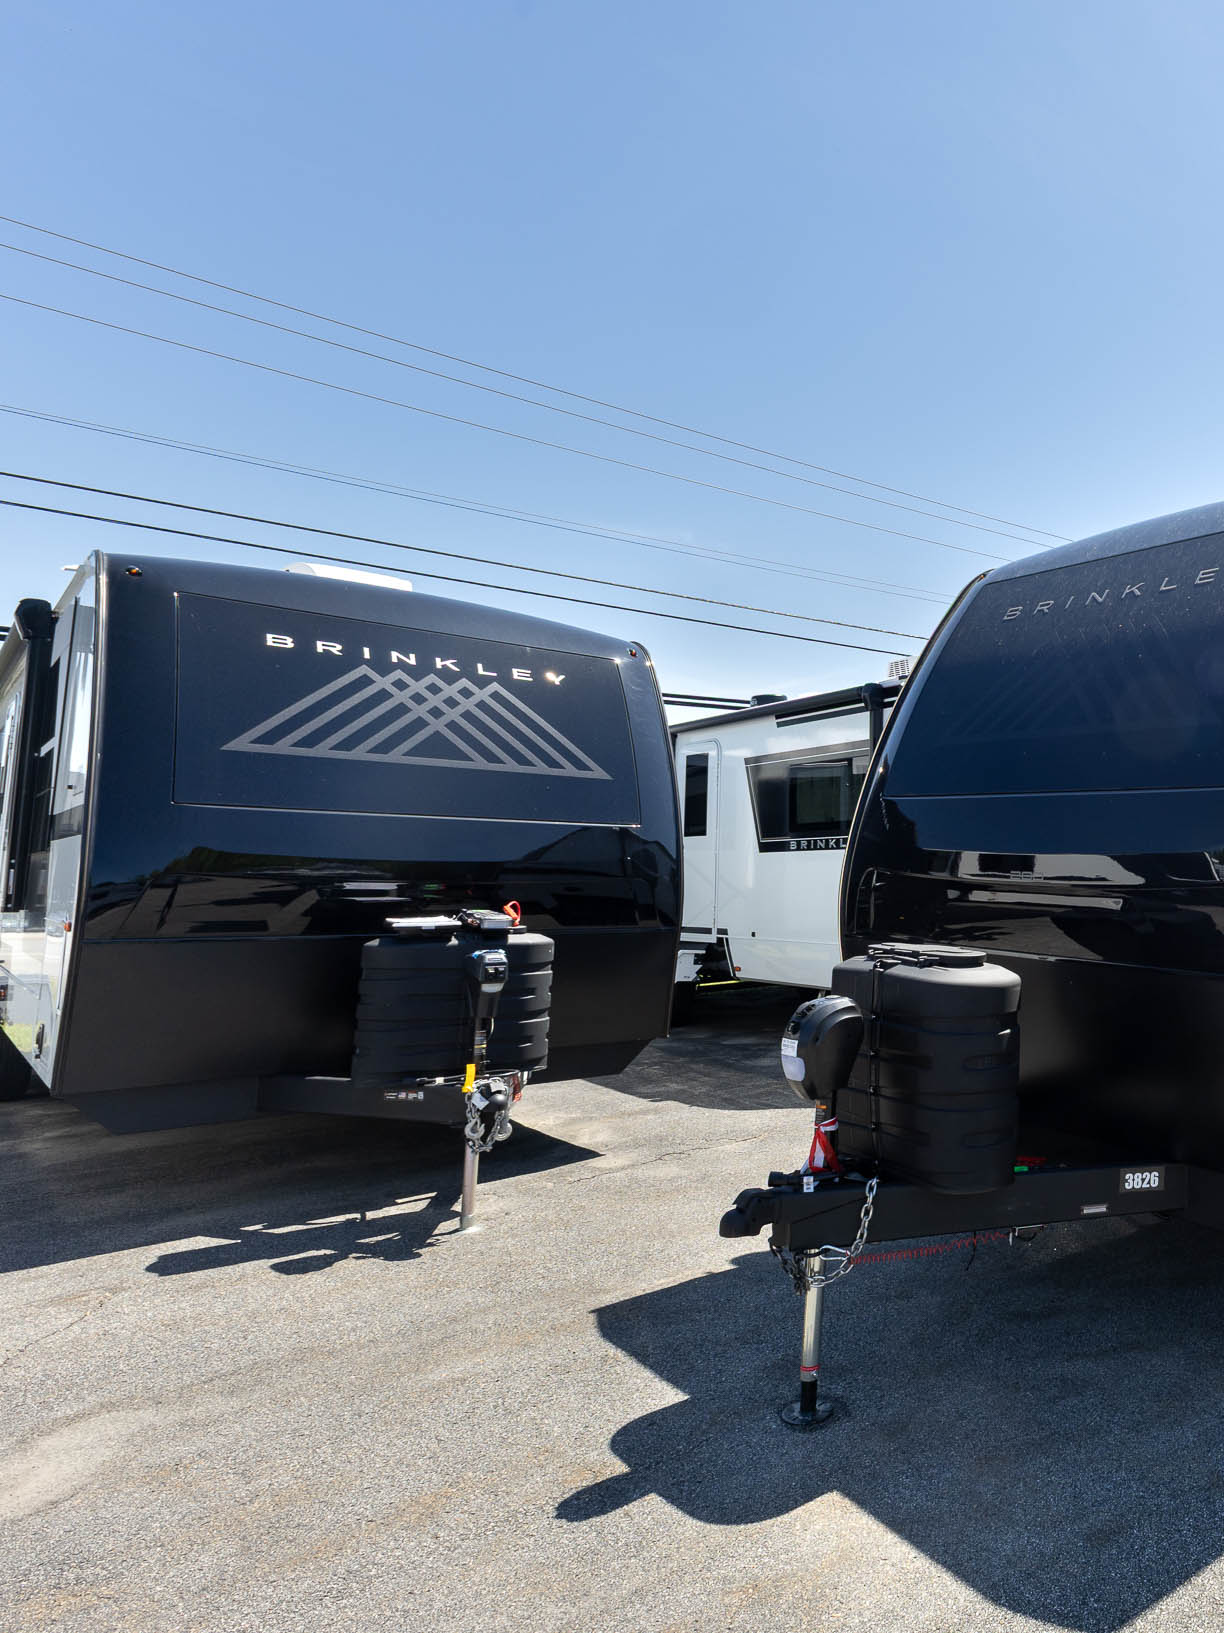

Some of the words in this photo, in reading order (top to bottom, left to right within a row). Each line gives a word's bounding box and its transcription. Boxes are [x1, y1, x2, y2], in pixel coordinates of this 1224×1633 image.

[265, 633, 566, 685] BRINKLEY
[789, 839, 847, 850] BRINKL
[1125, 1171, 1159, 1189] 3826
